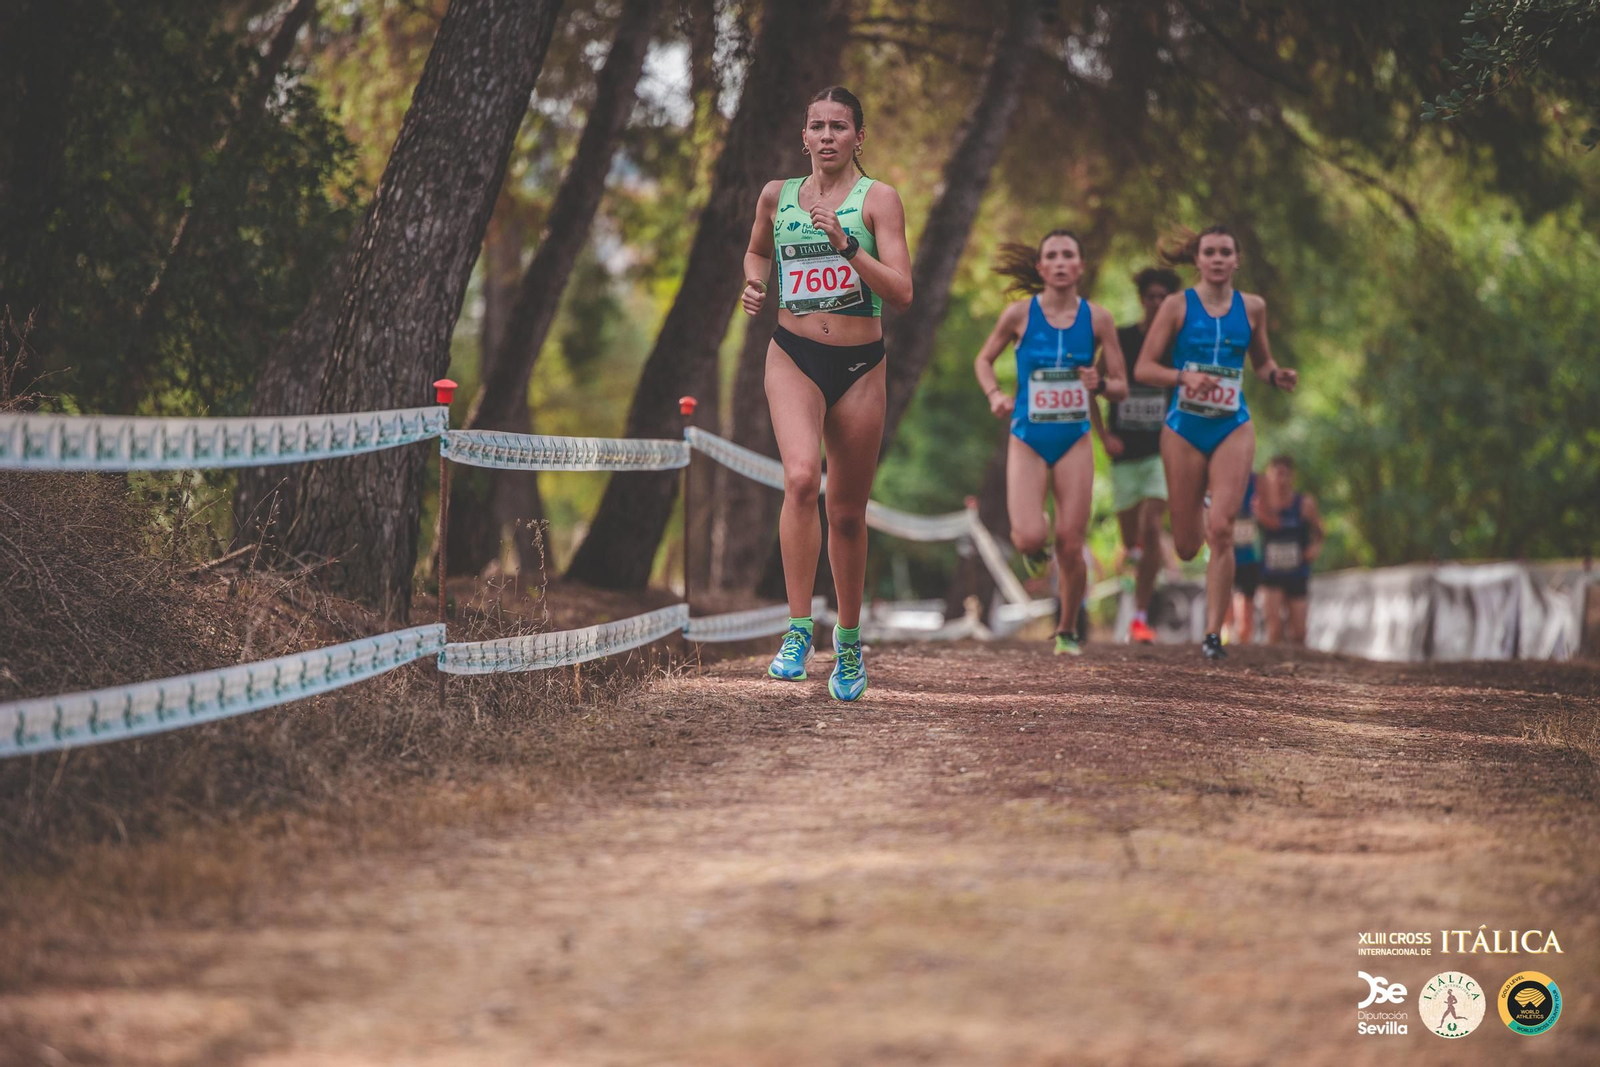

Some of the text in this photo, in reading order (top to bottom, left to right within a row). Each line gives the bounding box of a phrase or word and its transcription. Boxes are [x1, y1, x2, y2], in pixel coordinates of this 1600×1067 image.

[799, 243, 833, 254] ITÁLICA
[789, 266, 855, 295] 7602
[1034, 389, 1084, 409] 6303
